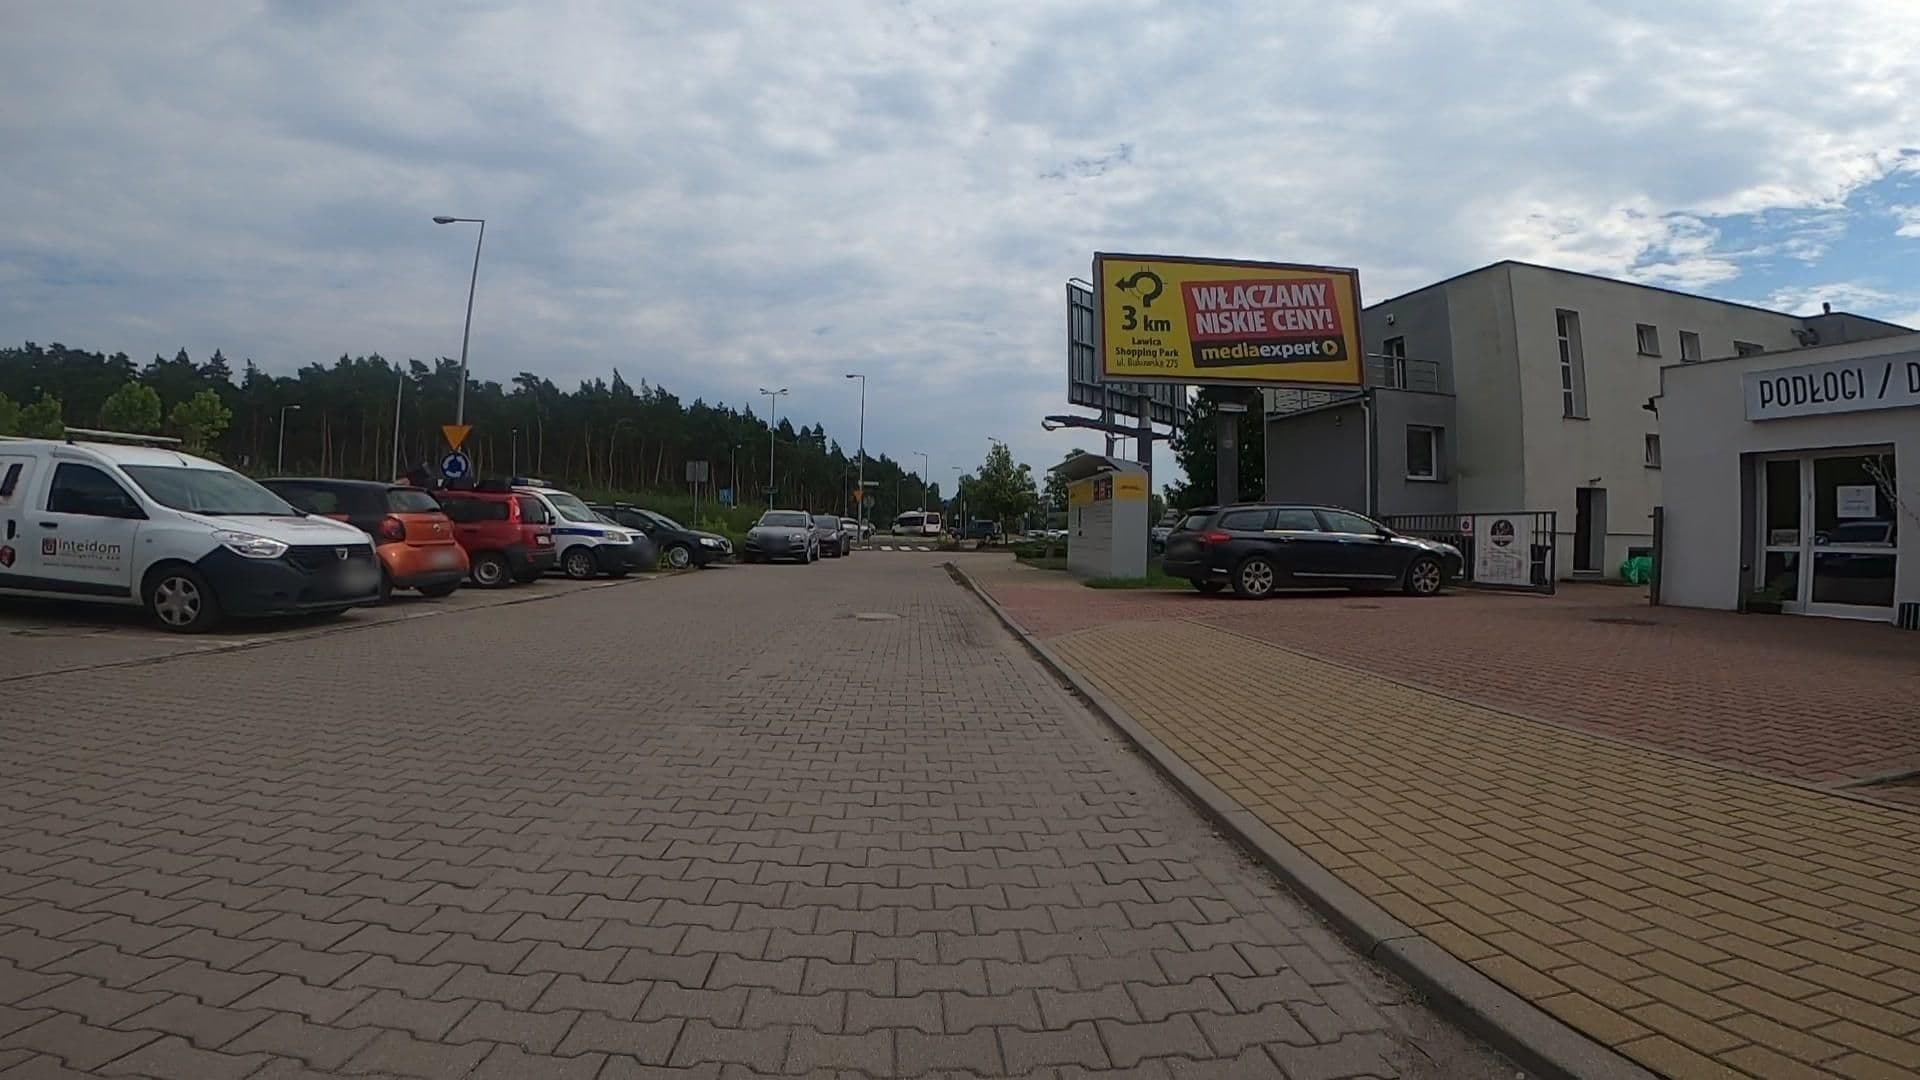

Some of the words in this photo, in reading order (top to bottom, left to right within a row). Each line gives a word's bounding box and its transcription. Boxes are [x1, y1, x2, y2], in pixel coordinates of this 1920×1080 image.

[1191, 284, 1326, 310] WŁĄCZAMY
[1122, 305, 1138, 330] 3
[1144, 314, 1171, 332] km
[1195, 310, 1267, 335] NISKIE
[1272, 308, 1334, 331] CENY!
[1115, 346, 1158, 358] Shopping
[1159, 348, 1179, 357] Park
[1201, 341, 1320, 361] mediaexpert
[1759, 367, 1864, 408] PODŁOGI
